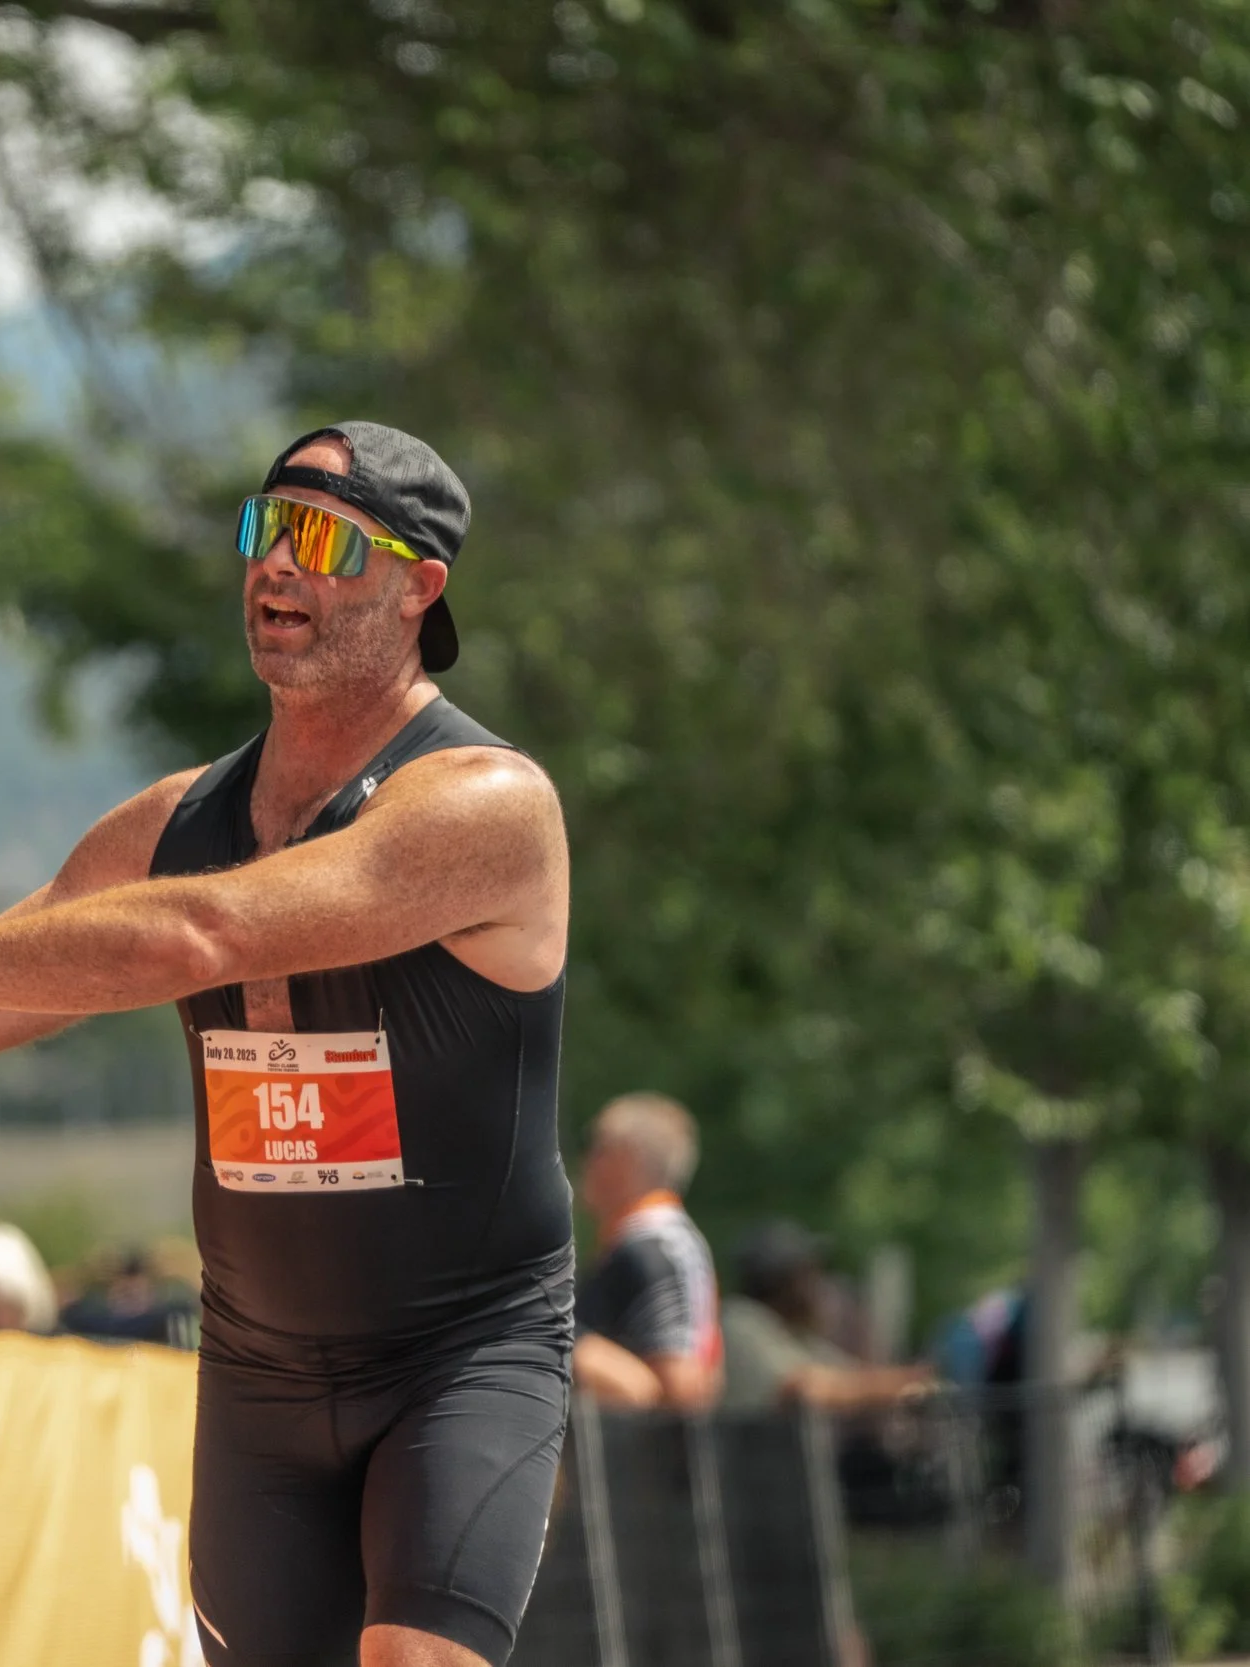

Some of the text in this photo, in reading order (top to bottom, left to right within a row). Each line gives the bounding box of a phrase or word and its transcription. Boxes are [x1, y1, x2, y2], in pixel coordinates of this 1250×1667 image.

[206, 1046, 257, 1061] July 20, 2025
[324, 1048, 377, 1063] Standard
[252, 1082, 325, 1131] 154
[264, 1139, 318, 1161] LUCAS
[318, 1175, 339, 1185] 70
